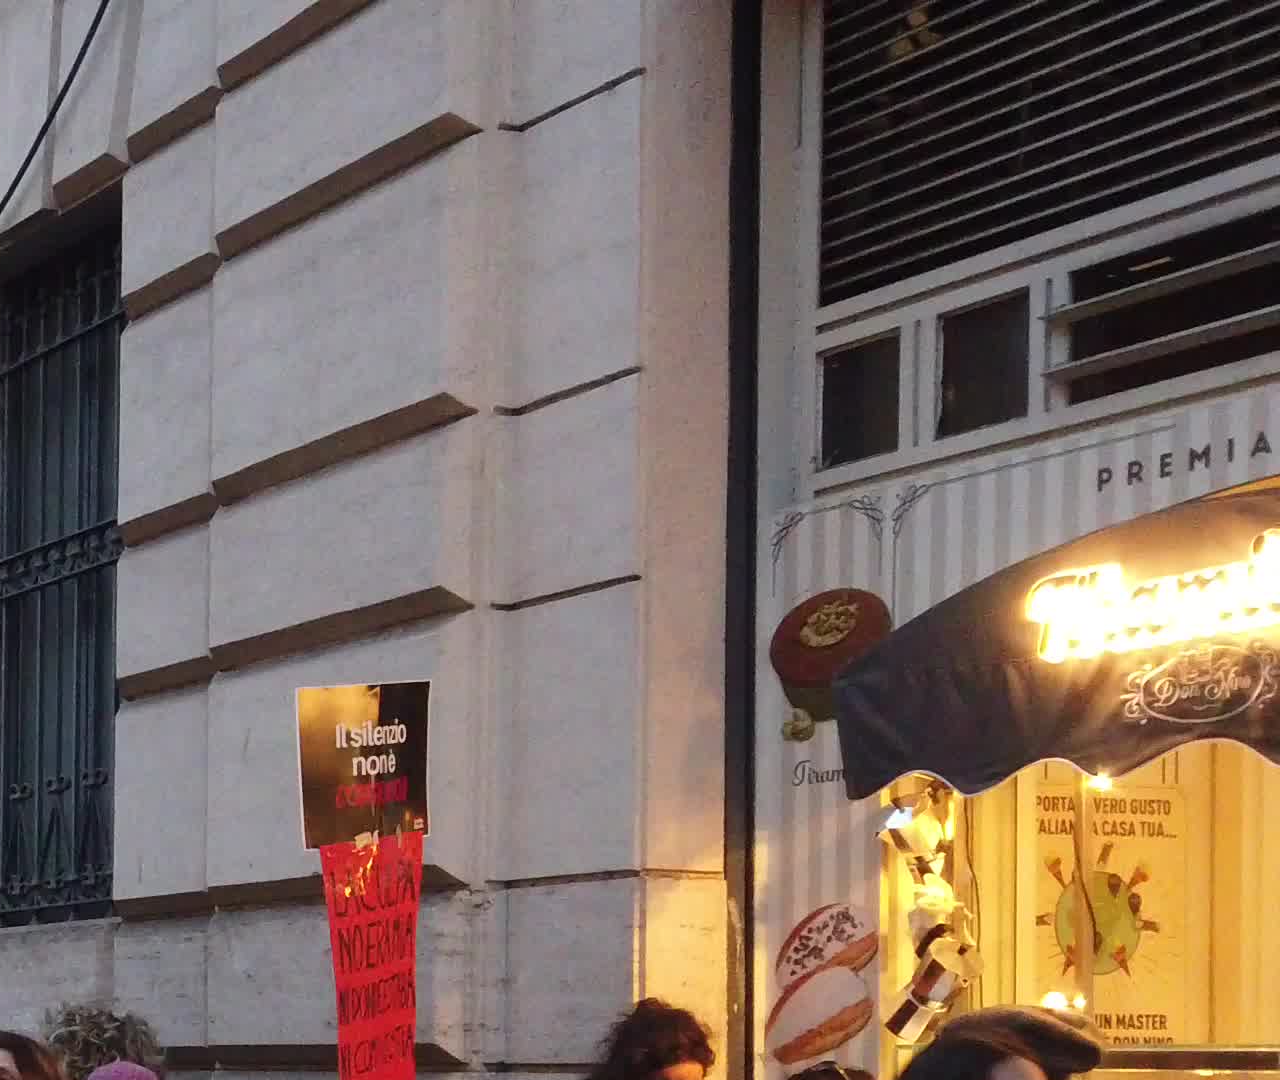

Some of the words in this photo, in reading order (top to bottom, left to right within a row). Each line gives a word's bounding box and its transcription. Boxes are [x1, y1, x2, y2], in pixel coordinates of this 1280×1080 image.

[1097, 431, 1273, 493] PREMIA
[335, 722, 348, 749] Il
[350, 718, 407, 748] silenzio
[1093, 797, 1127, 814] VERO
[1129, 798, 1172, 816] GUSTO
[1101, 820, 1137, 837] CASA
[1115, 1012, 1169, 1031] MASTER
